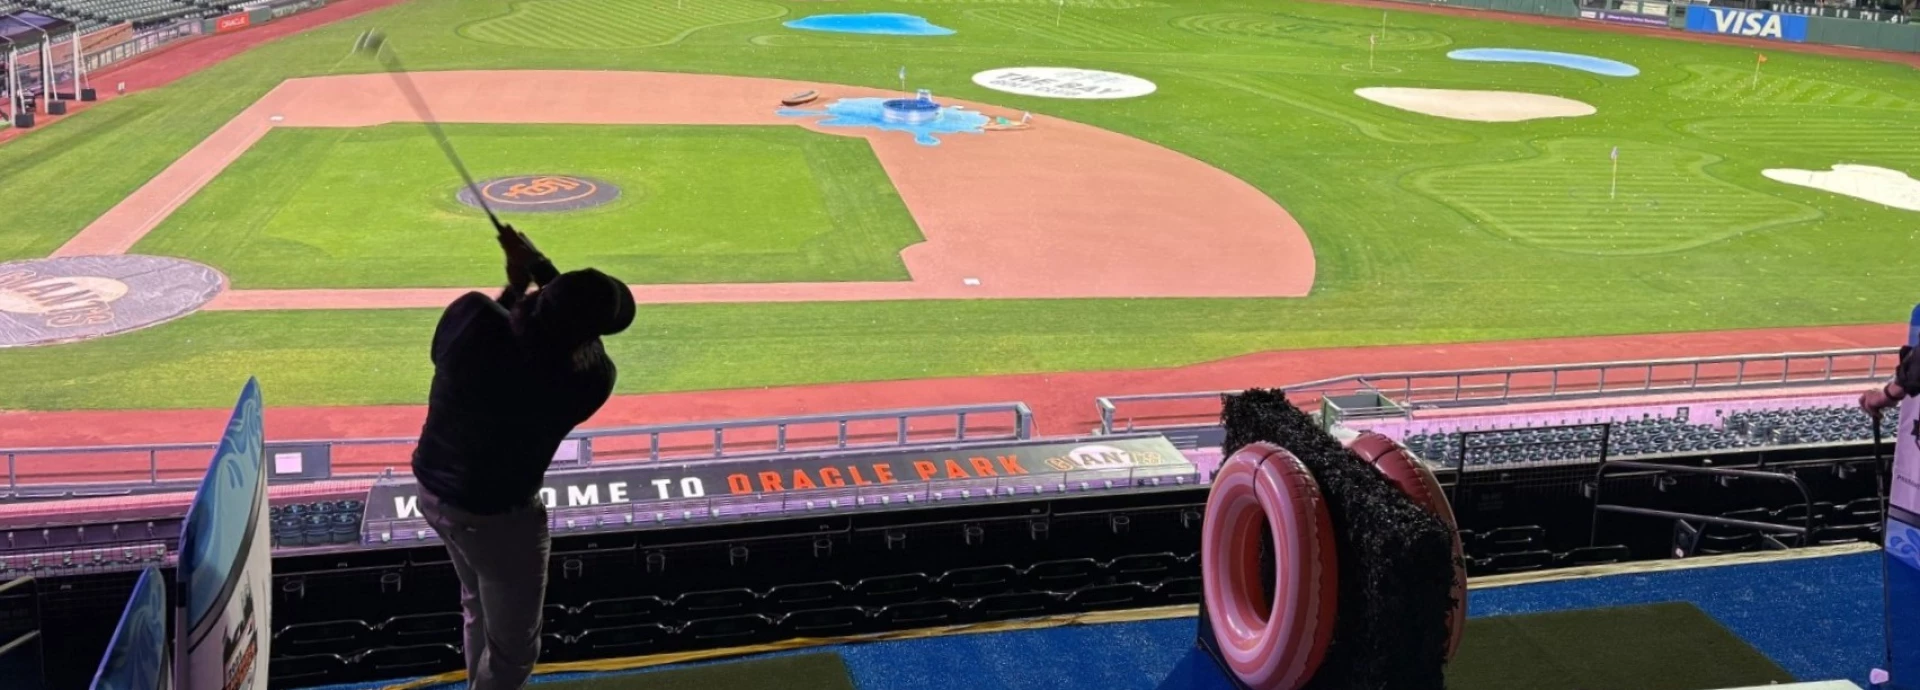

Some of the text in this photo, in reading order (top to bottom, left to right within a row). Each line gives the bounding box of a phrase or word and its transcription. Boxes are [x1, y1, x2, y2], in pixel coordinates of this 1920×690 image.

[1772, 4, 1824, 16] WELCOME
[1836, 9, 1848, 18] TO
[1860, 11, 1879, 21] THE
[221, 16, 246, 28] ORACLE
[1709, 8, 1782, 38] VISA
[996, 72, 1059, 84] THE
[394, 454, 1029, 519] WOME TO ORACLE PARK
